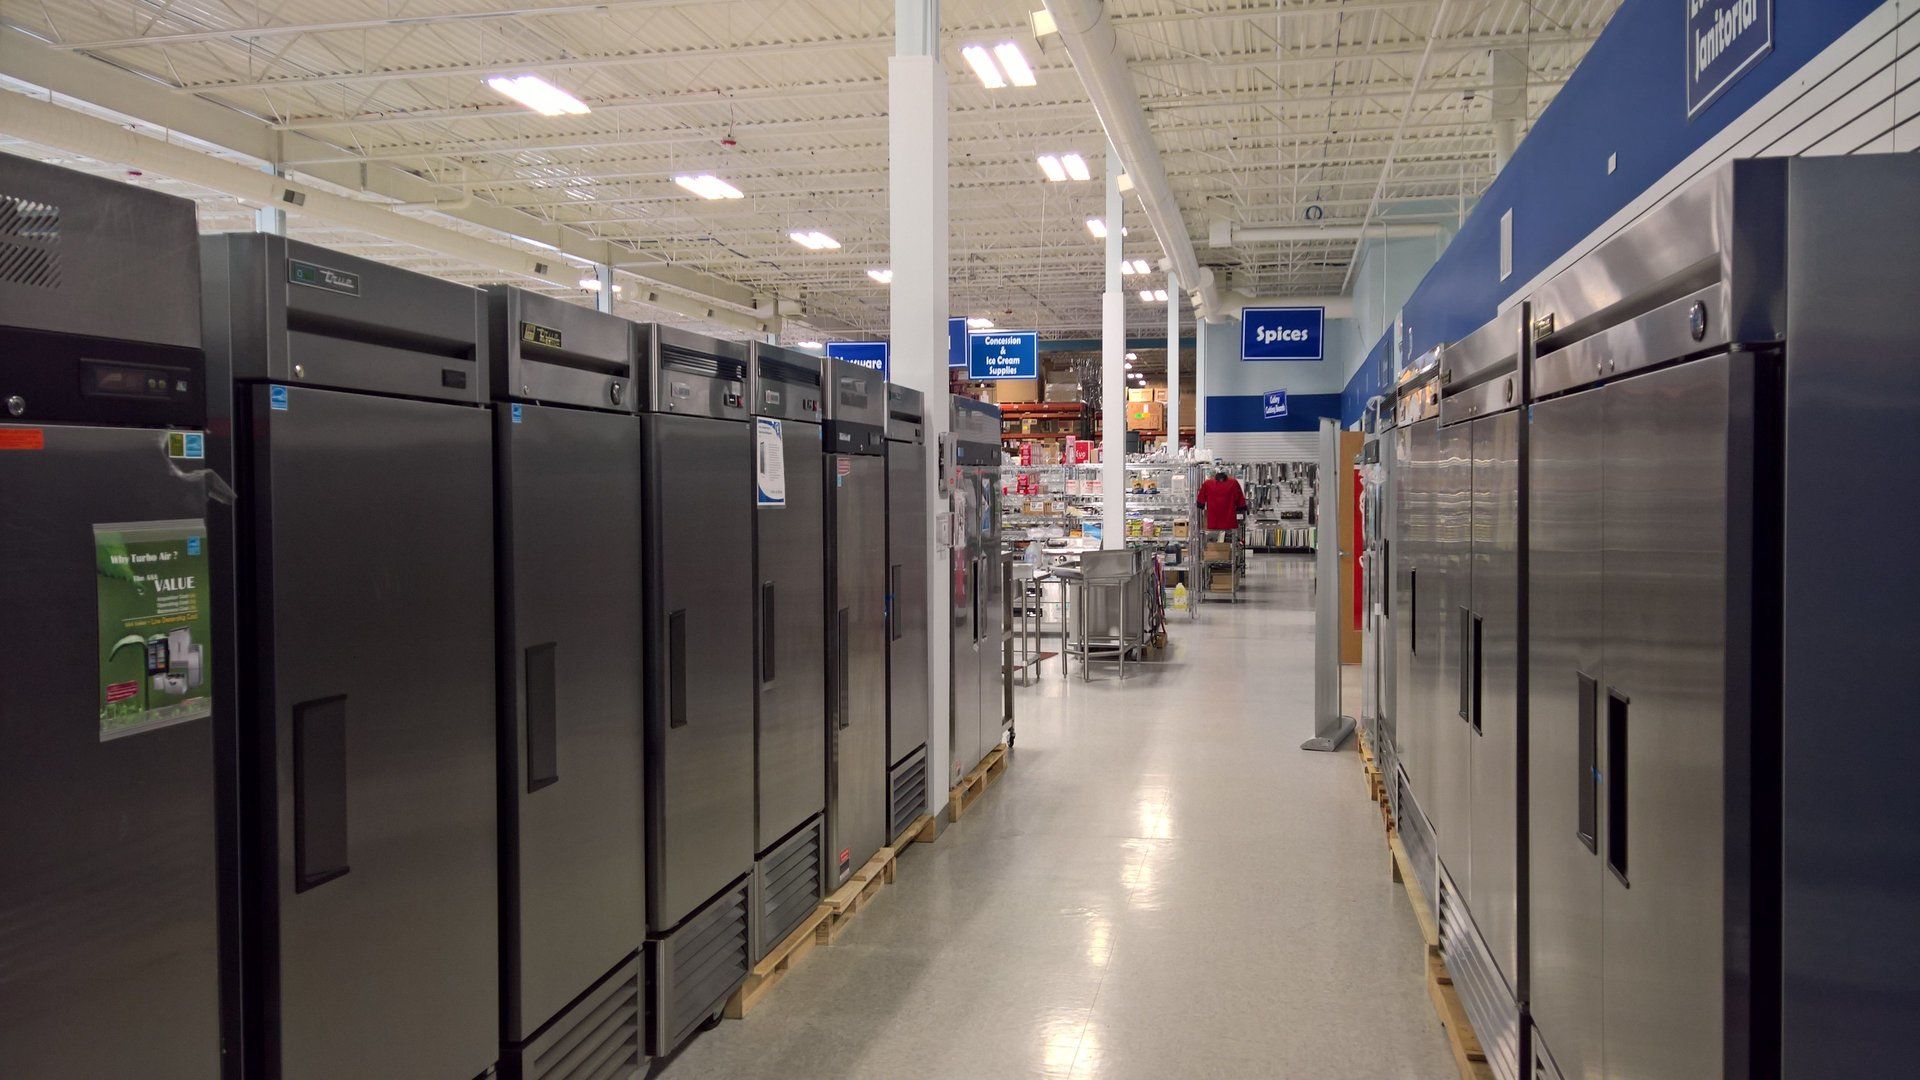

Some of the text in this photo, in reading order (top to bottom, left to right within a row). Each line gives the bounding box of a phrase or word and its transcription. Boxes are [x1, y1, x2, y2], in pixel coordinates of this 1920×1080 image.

[1695, 0, 1757, 83] Janitorial
[985, 335, 1021, 345] Concession
[1256, 325, 1308, 345] Spices
[1000, 346, 1006, 355] &
[986, 355, 1020, 365] Ice Cream
[989, 366, 1017, 376] Supplies
[110, 555, 129, 565] Why
[131, 553, 157, 563] Turbo
[159, 552, 172, 561] Air
[154, 576, 195, 592] VALUE
